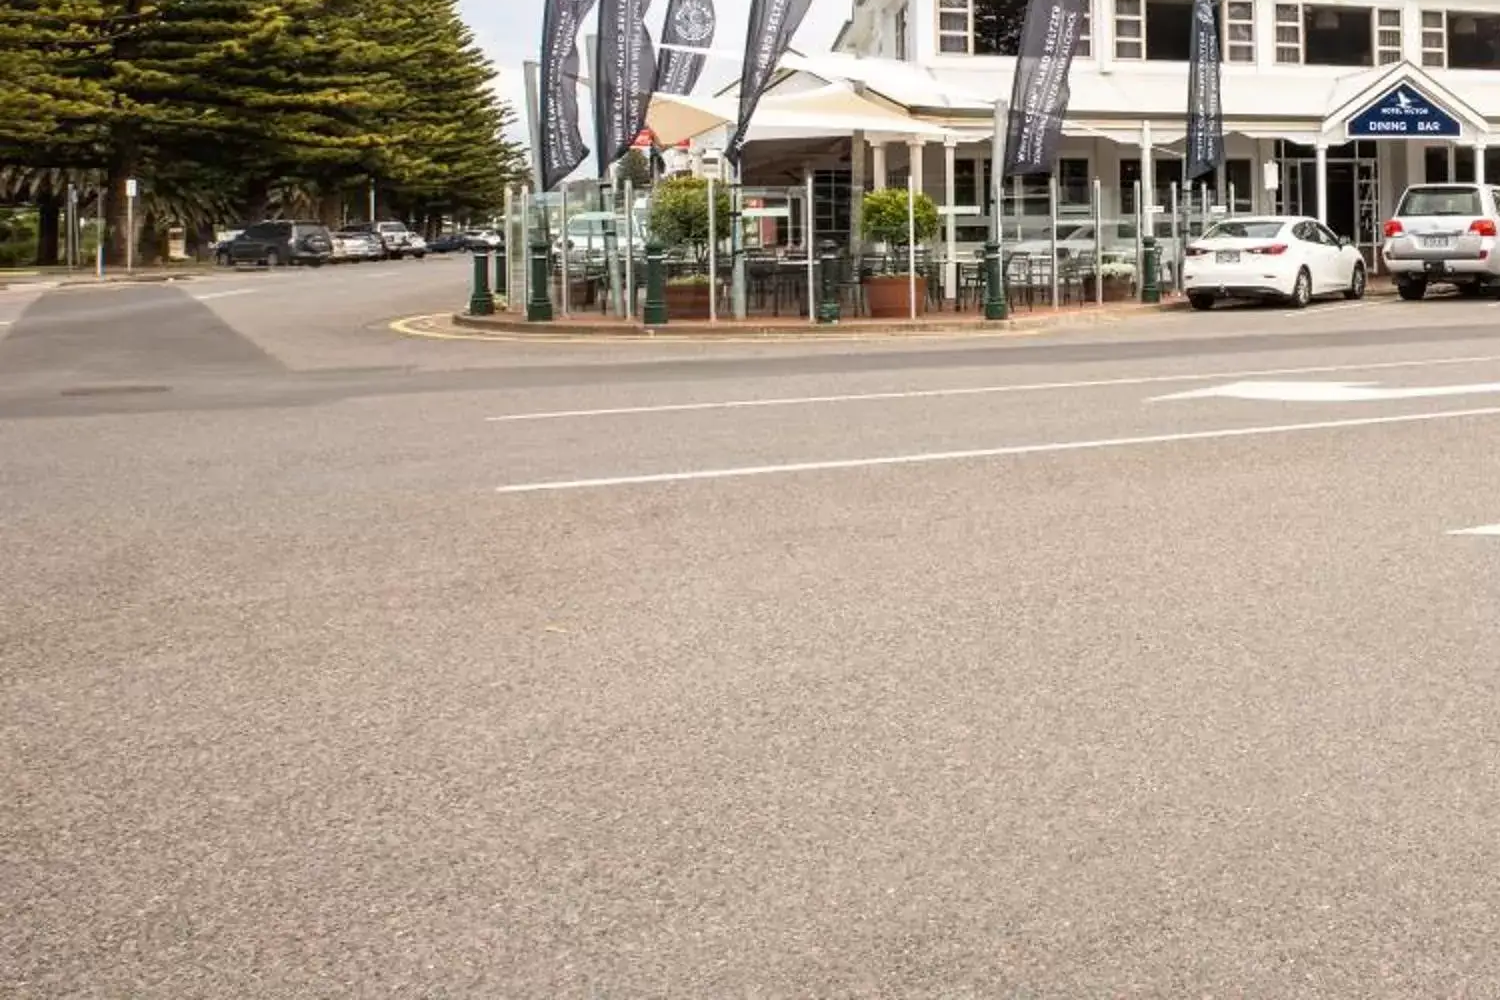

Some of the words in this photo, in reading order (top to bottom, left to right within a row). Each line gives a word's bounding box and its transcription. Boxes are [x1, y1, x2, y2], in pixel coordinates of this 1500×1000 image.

[1381, 107, 1403, 115] HOTEL
[1369, 121, 1408, 132] DINING
[1417, 121, 1441, 132] BAR
